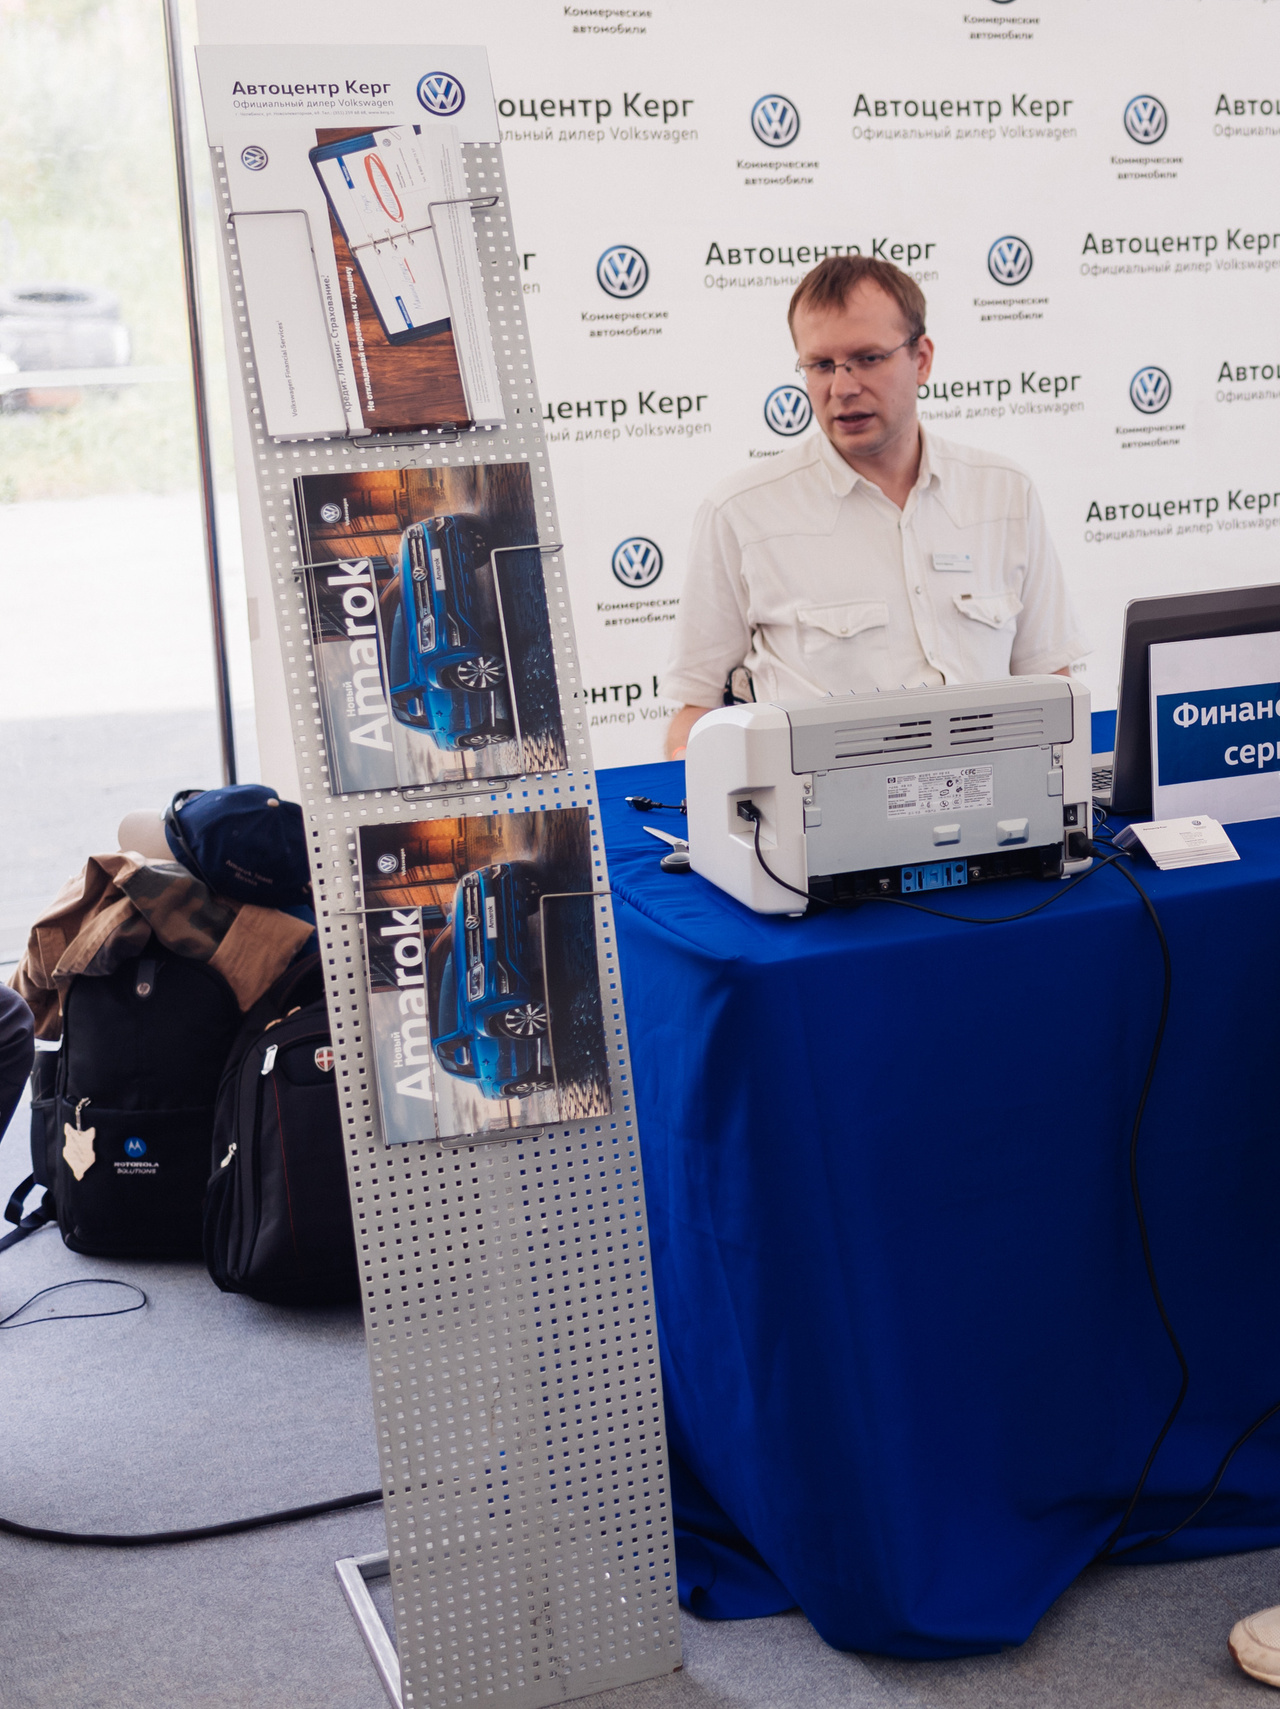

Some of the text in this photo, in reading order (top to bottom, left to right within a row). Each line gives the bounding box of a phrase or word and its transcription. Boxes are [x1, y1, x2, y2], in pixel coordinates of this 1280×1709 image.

[564, 6, 652, 18] Коммерческие
[573, 24, 646, 34] автомобили
[970, 30, 1033, 39] автомобили
[233, 80, 390, 97] Автоцентр Керг
[233, 100, 303, 108] Официальный
[338, 99, 393, 108] Volkswagen
[624, 93, 694, 123] Керг
[853, 94, 1073, 123] Автоцентр Керг
[559, 130, 605, 143] дилер
[610, 126, 698, 144] Volkswagen
[852, 125, 1077, 141] Официальный дилер Volkswagen
[737, 160, 819, 170] Коммерческие
[745, 175, 813, 185] автомобили
[1118, 170, 1177, 179] автомобили
[872, 238, 936, 267] Керг
[1082, 233, 1217, 257] Автоцентр
[1080, 261, 1171, 277] Официальный
[1174, 262, 1212, 273] дилер
[581, 312, 668, 321] Коммерческие
[981, 311, 1043, 321] автомобили
[590, 326, 662, 337] автомобили
[282, 349, 291, 378] Financial
[335, 340, 346, 375] Лизинг.
[1021, 372, 1081, 398] Керг
[286, 377, 298, 418] Volkswagen
[341, 377, 352, 412] Кредит.
[367, 399, 375, 411] Не
[639, 391, 707, 419] Керг
[966, 407, 1005, 419] дилер
[1009, 402, 1084, 416] Volkswagen
[575, 428, 620, 442] дилер
[625, 423, 711, 438] Volkswagen
[1121, 438, 1180, 449] автомобили
[1086, 498, 1219, 522] Автоцентр
[1084, 527, 1172, 543] Официальный
[1171, 523, 1213, 535] дилер
[435, 557, 444, 581] Amarok
[605, 613, 675, 626] автомобили
[327, 559, 393, 751] Amarok
[346, 680, 355, 717] Новый
[591, 712, 635, 726] дилер
[487, 905, 496, 928] Amarok
[380, 909, 439, 1102] Amarok
[392, 1031, 402, 1068] Новый
